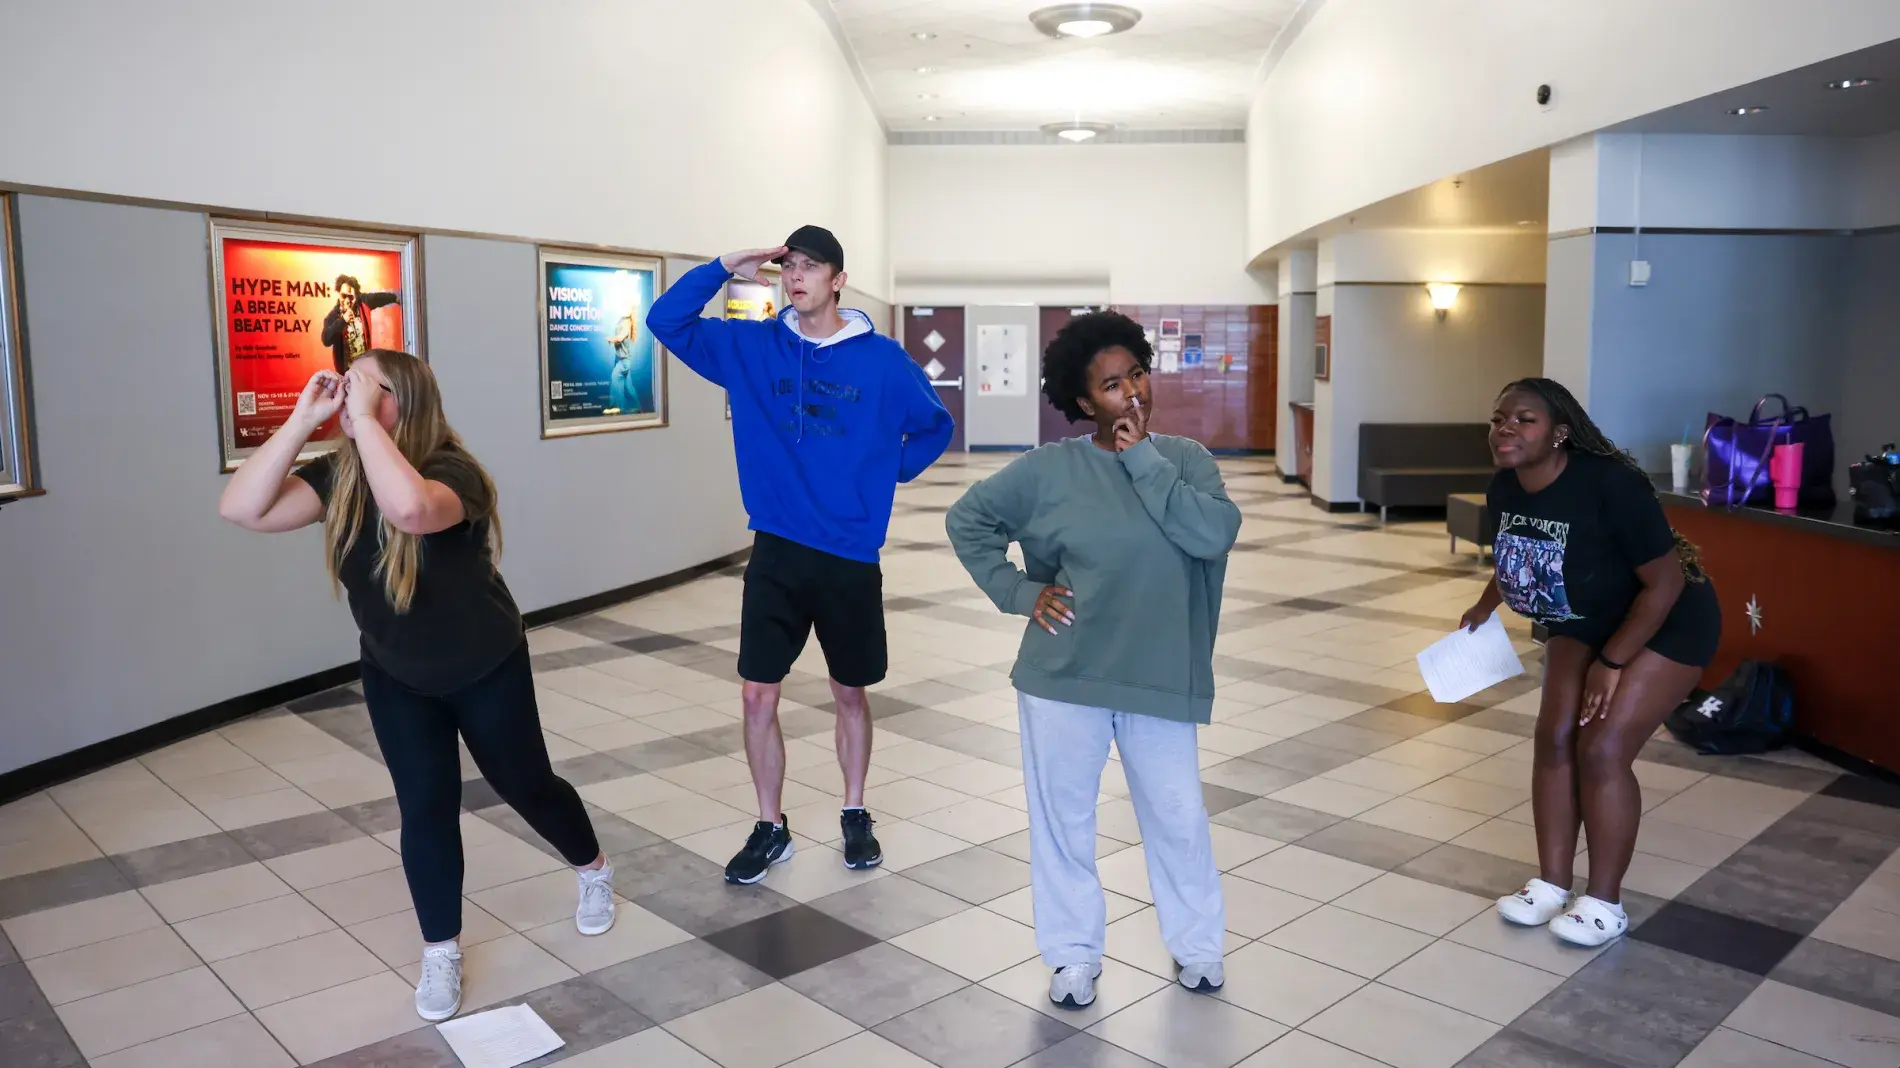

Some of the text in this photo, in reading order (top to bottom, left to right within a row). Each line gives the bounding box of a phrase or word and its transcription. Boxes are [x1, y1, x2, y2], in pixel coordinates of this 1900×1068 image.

[231, 278, 331, 298] HYPE MAN:
[549, 287, 593, 302] VISIONS
[233, 300, 297, 315] A BREAK
[549, 305, 562, 320] IN
[234, 319, 312, 333] BEAT PLAY
[549, 324, 569, 332] DANCE
[1499, 511, 1570, 549] BLCK VOICES
